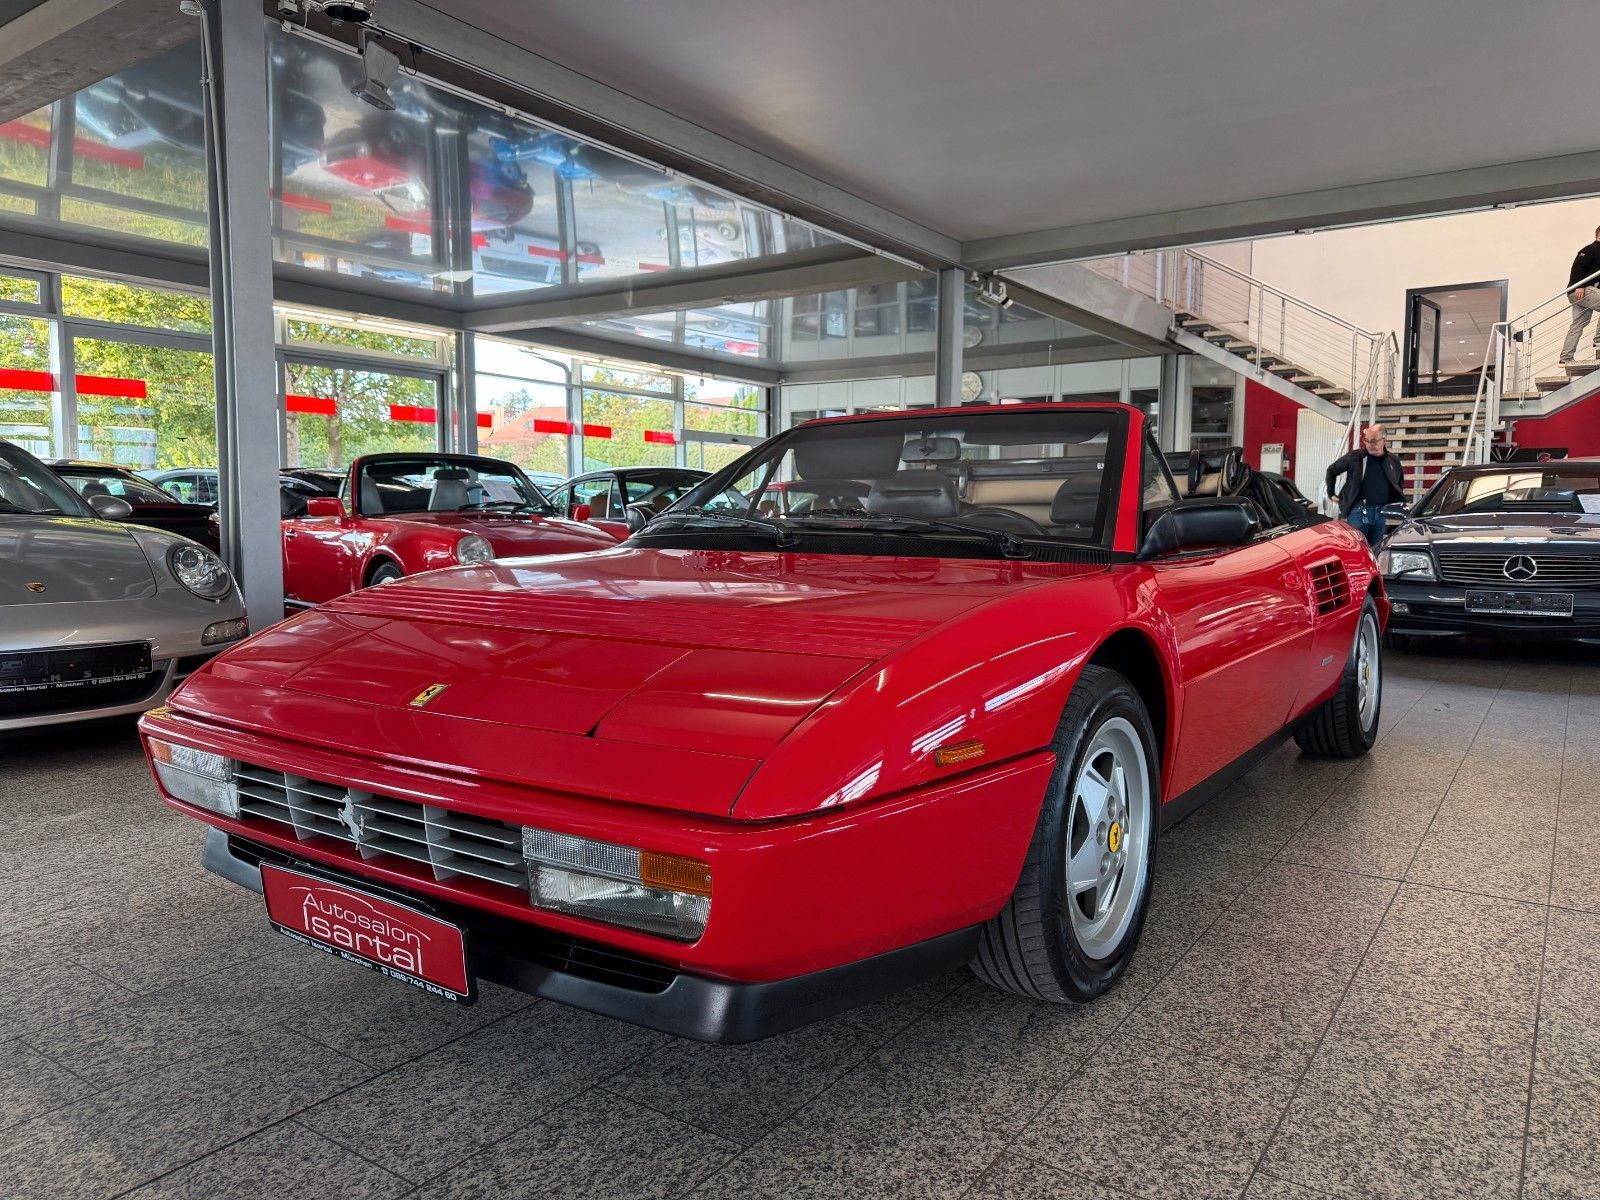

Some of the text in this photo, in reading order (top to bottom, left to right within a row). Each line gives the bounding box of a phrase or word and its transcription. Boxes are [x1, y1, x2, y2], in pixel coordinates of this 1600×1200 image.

[303, 892, 421, 948] Autosalon
[304, 907, 423, 975] Isartal
[310, 939, 333, 954] Isartal
[340, 952, 373, 970] München
[389, 969, 425, 989] 089/744
[425, 984, 444, 997] 244
[444, 990, 457, 1002] 60
